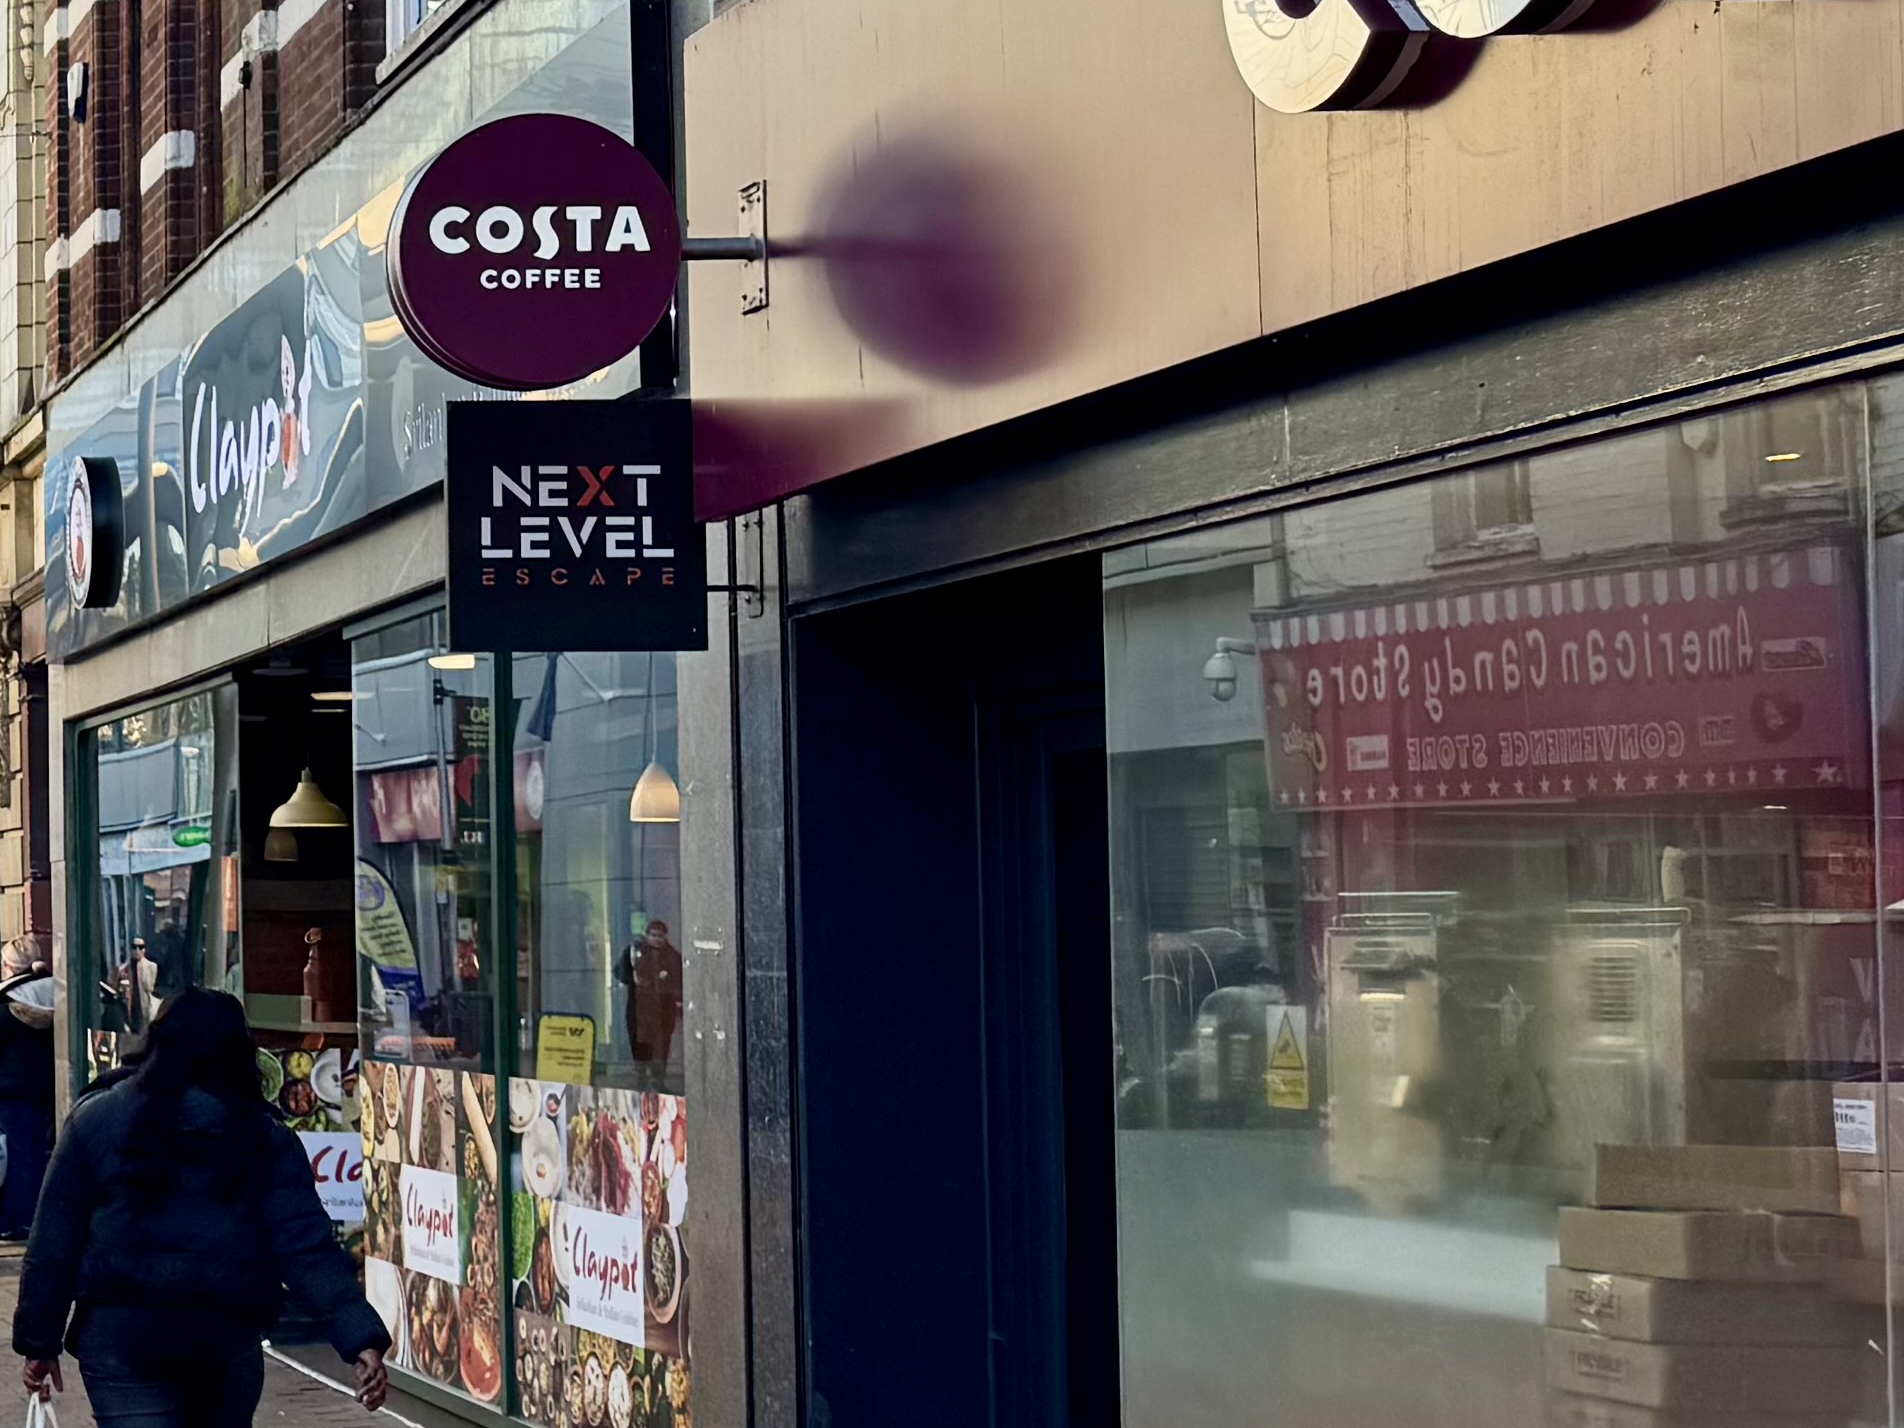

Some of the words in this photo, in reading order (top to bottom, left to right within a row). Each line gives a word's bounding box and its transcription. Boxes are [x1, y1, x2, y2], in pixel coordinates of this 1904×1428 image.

[429, 205, 651, 260] COSTA
[479, 268, 601, 290] COFFEE
[190, 334, 312, 539] Claypot
[403, 391, 448, 461] Srilan
[492, 465, 661, 507] NEXT
[481, 516, 675, 558] LEVEL
[482, 567, 675, 586] ESCAPE
[406, 1183, 454, 1247] Claypot
[573, 1225, 638, 1301] Claypot
